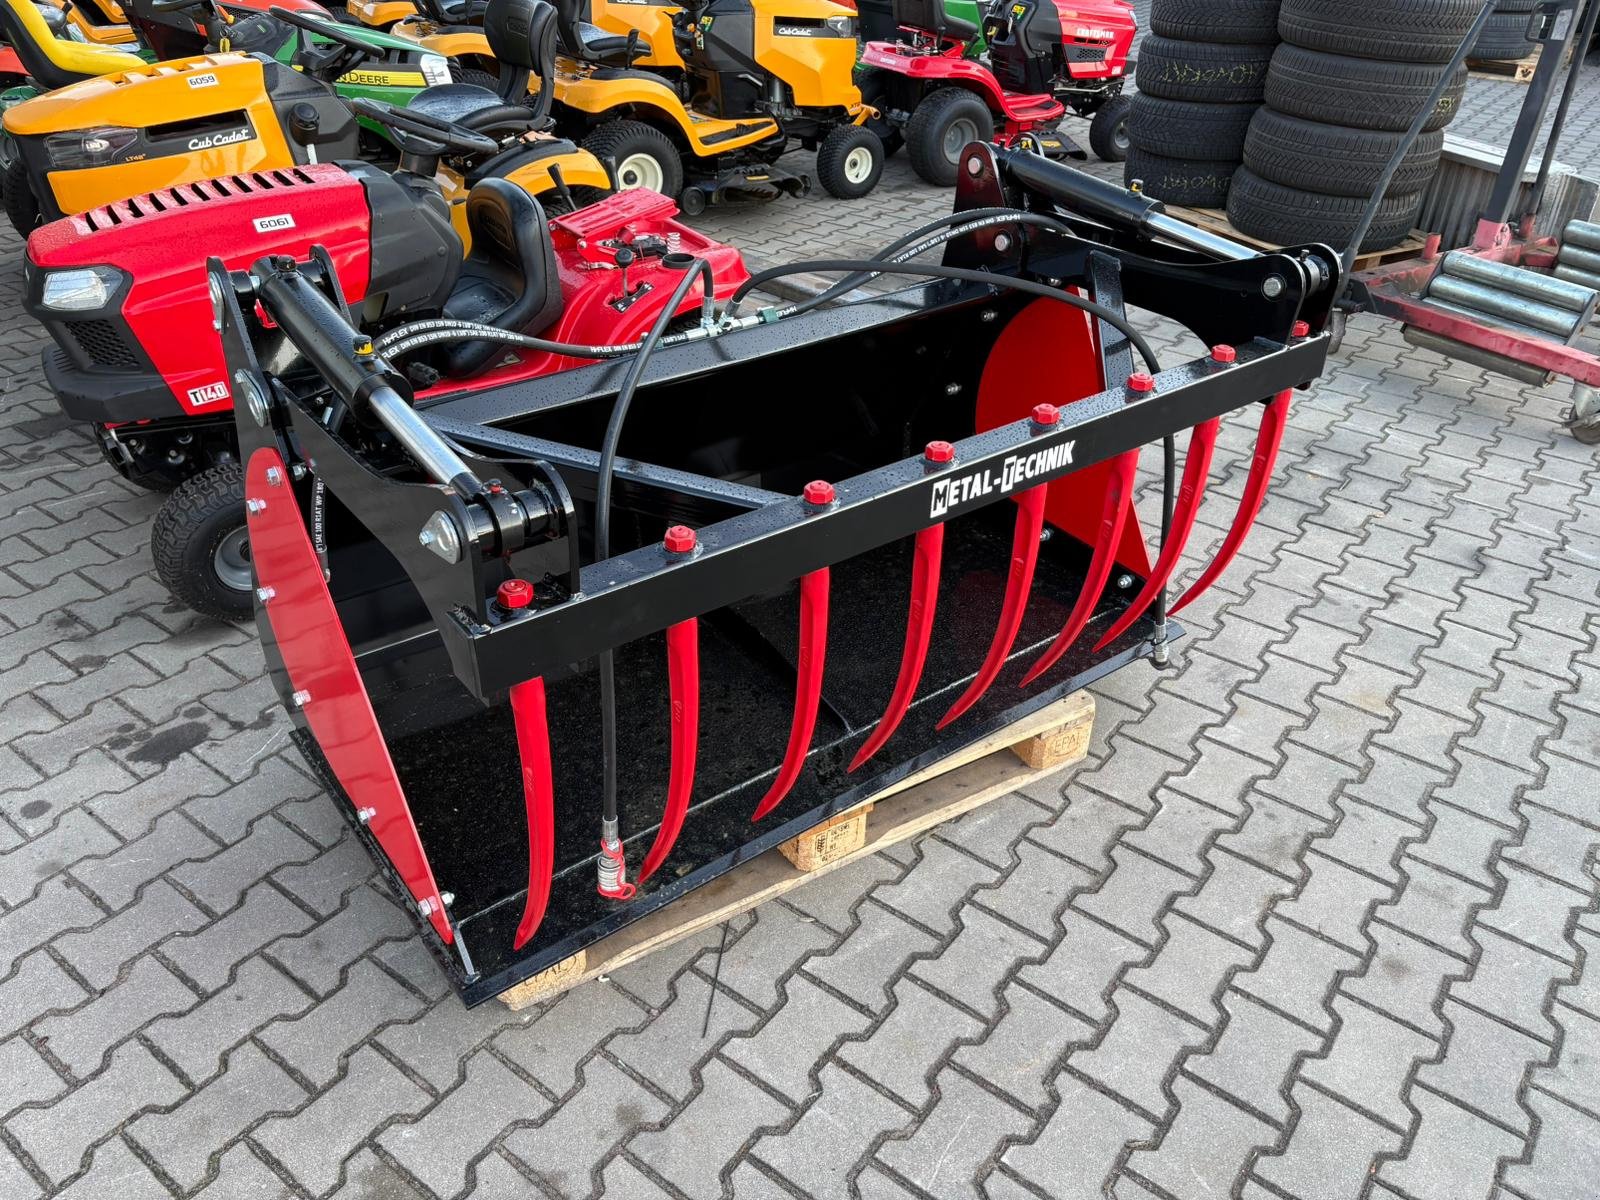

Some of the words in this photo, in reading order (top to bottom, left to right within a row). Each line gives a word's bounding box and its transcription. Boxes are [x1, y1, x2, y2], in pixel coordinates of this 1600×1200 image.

[1076, 28, 1115, 39] CRAFTSMAN
[189, 75, 216, 86] 6059
[349, 72, 390, 84] DEERE
[188, 139, 212, 150] Cub
[212, 129, 249, 145] Cadet
[259, 217, 290, 229] 6061
[188, 382, 229, 406] T140
